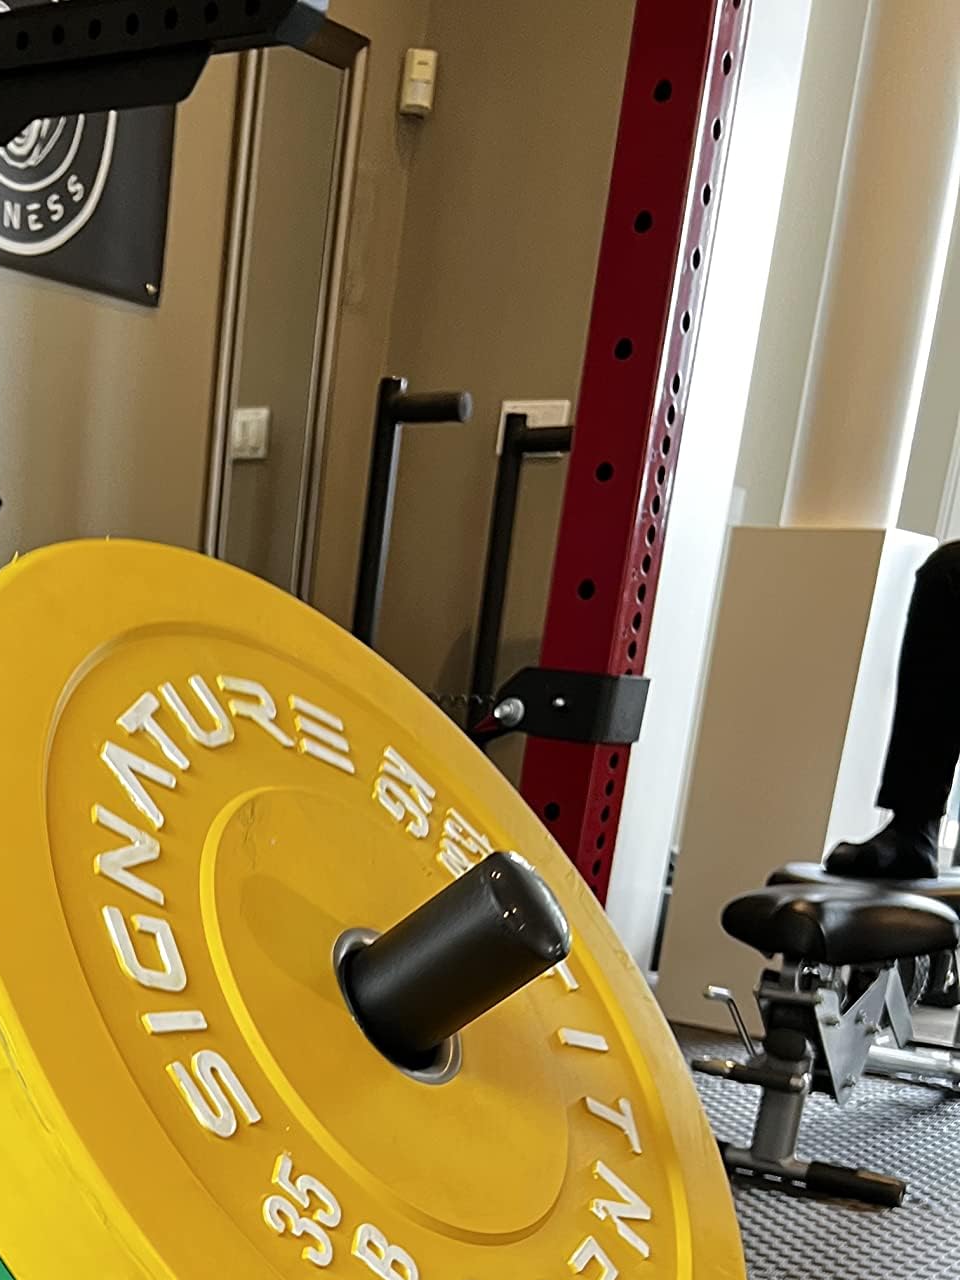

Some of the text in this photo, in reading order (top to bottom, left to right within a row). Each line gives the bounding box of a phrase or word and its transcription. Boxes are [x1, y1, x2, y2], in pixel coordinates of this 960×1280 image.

[372, 745, 437, 838] KG
[91, 674, 355, 1138] SIGNATURE
[262, 1151, 342, 1267] 35
